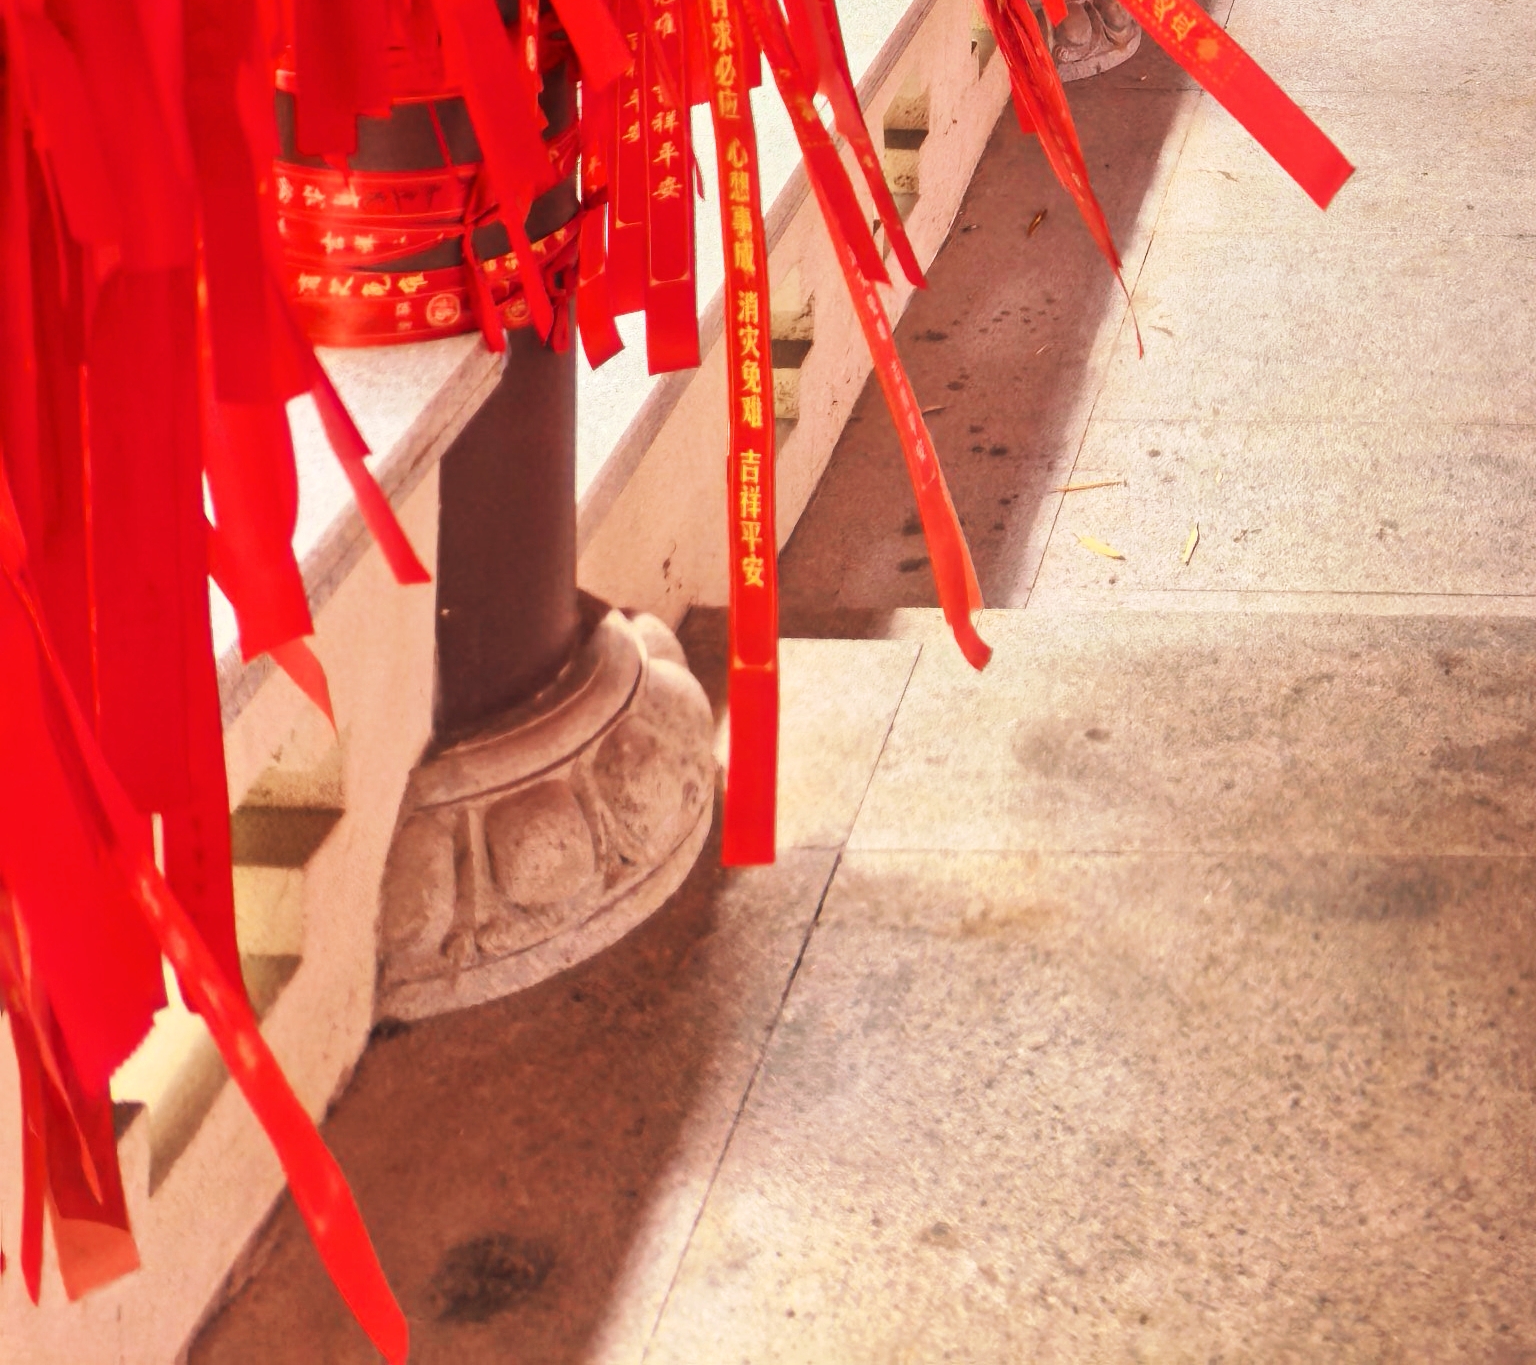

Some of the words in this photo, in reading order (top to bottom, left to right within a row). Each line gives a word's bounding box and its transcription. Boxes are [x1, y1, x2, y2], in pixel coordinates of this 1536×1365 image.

[726, 137, 756, 273] 心想事成
[737, 290, 764, 428] 消灾免难
[738, 448, 765, 588] 吉祥平安
